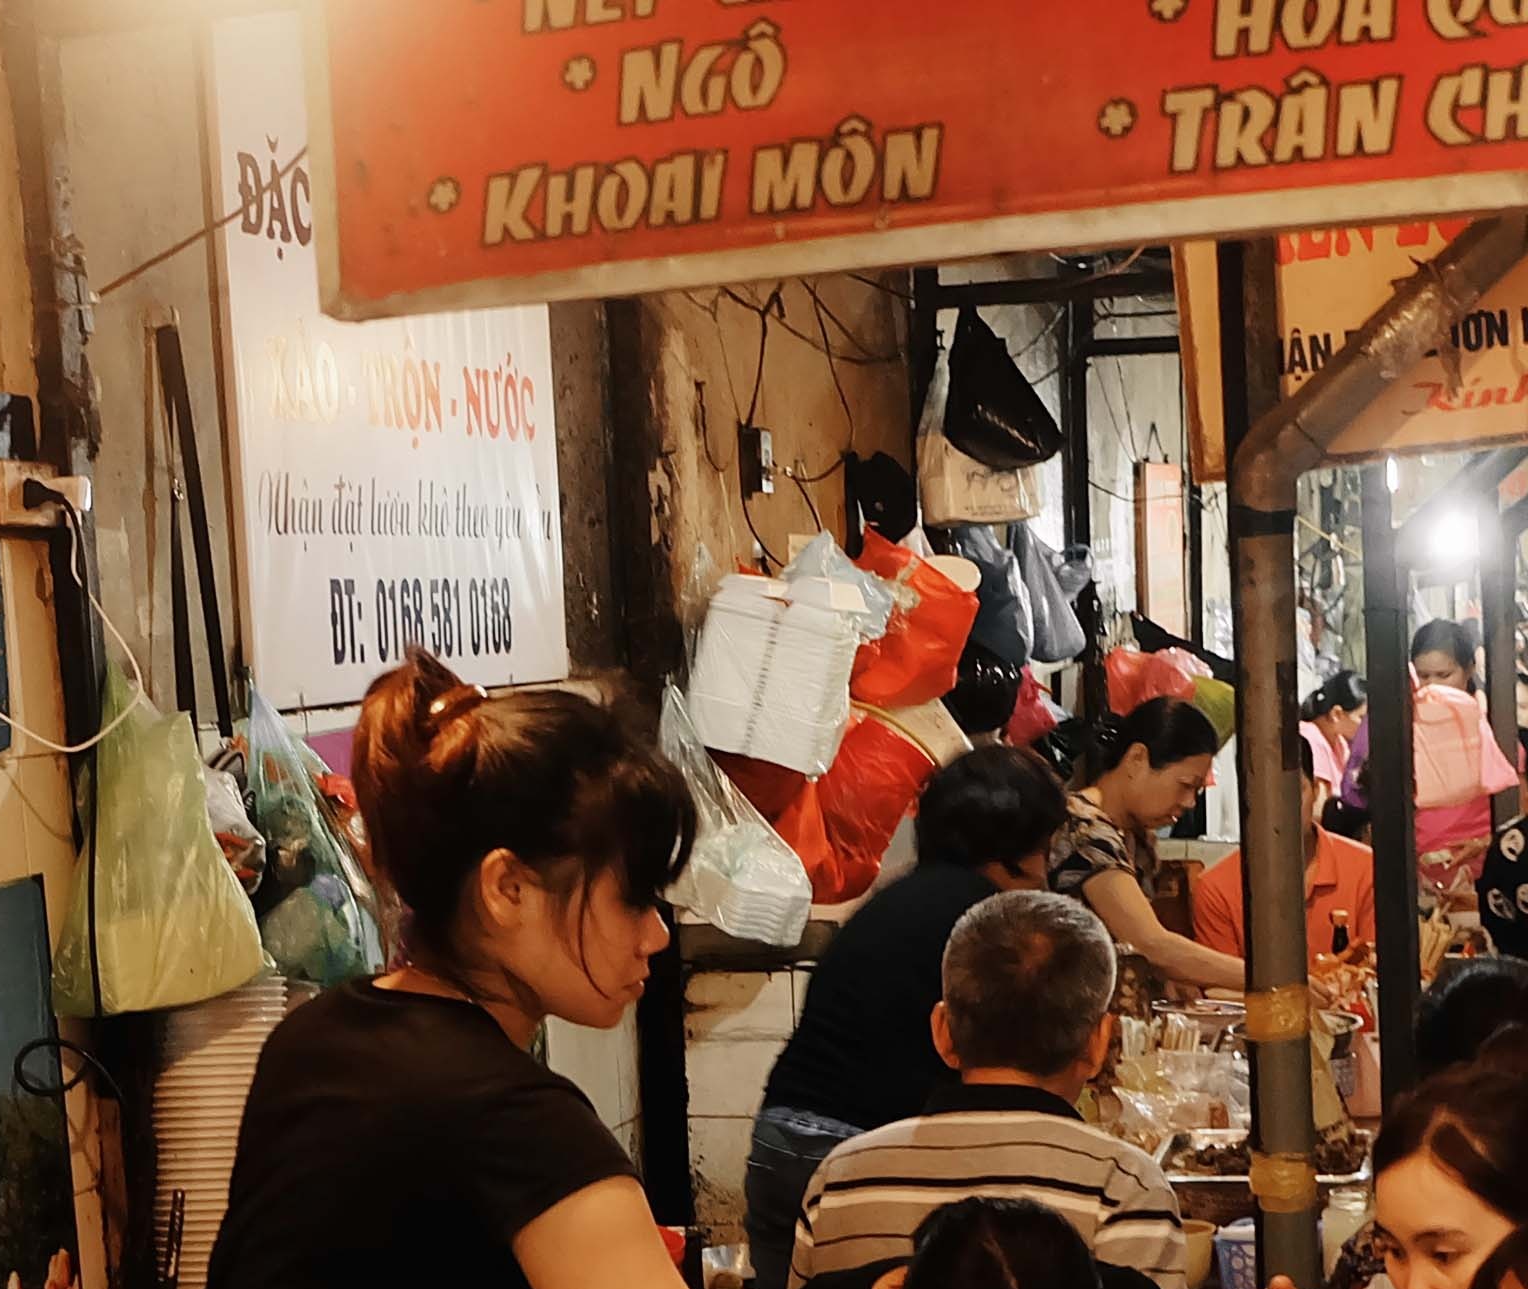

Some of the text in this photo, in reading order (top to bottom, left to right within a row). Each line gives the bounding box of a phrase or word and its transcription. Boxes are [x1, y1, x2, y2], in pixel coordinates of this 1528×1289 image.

[618, 17, 787, 127] NGÔ
[1162, 67, 1403, 174] TRÂN
[482, 114, 944, 247] KHOAI MÔN
[463, 352, 536, 442] NƯỚC
[430, 577, 463, 659] 581
[469, 577, 512, 657] 0168
